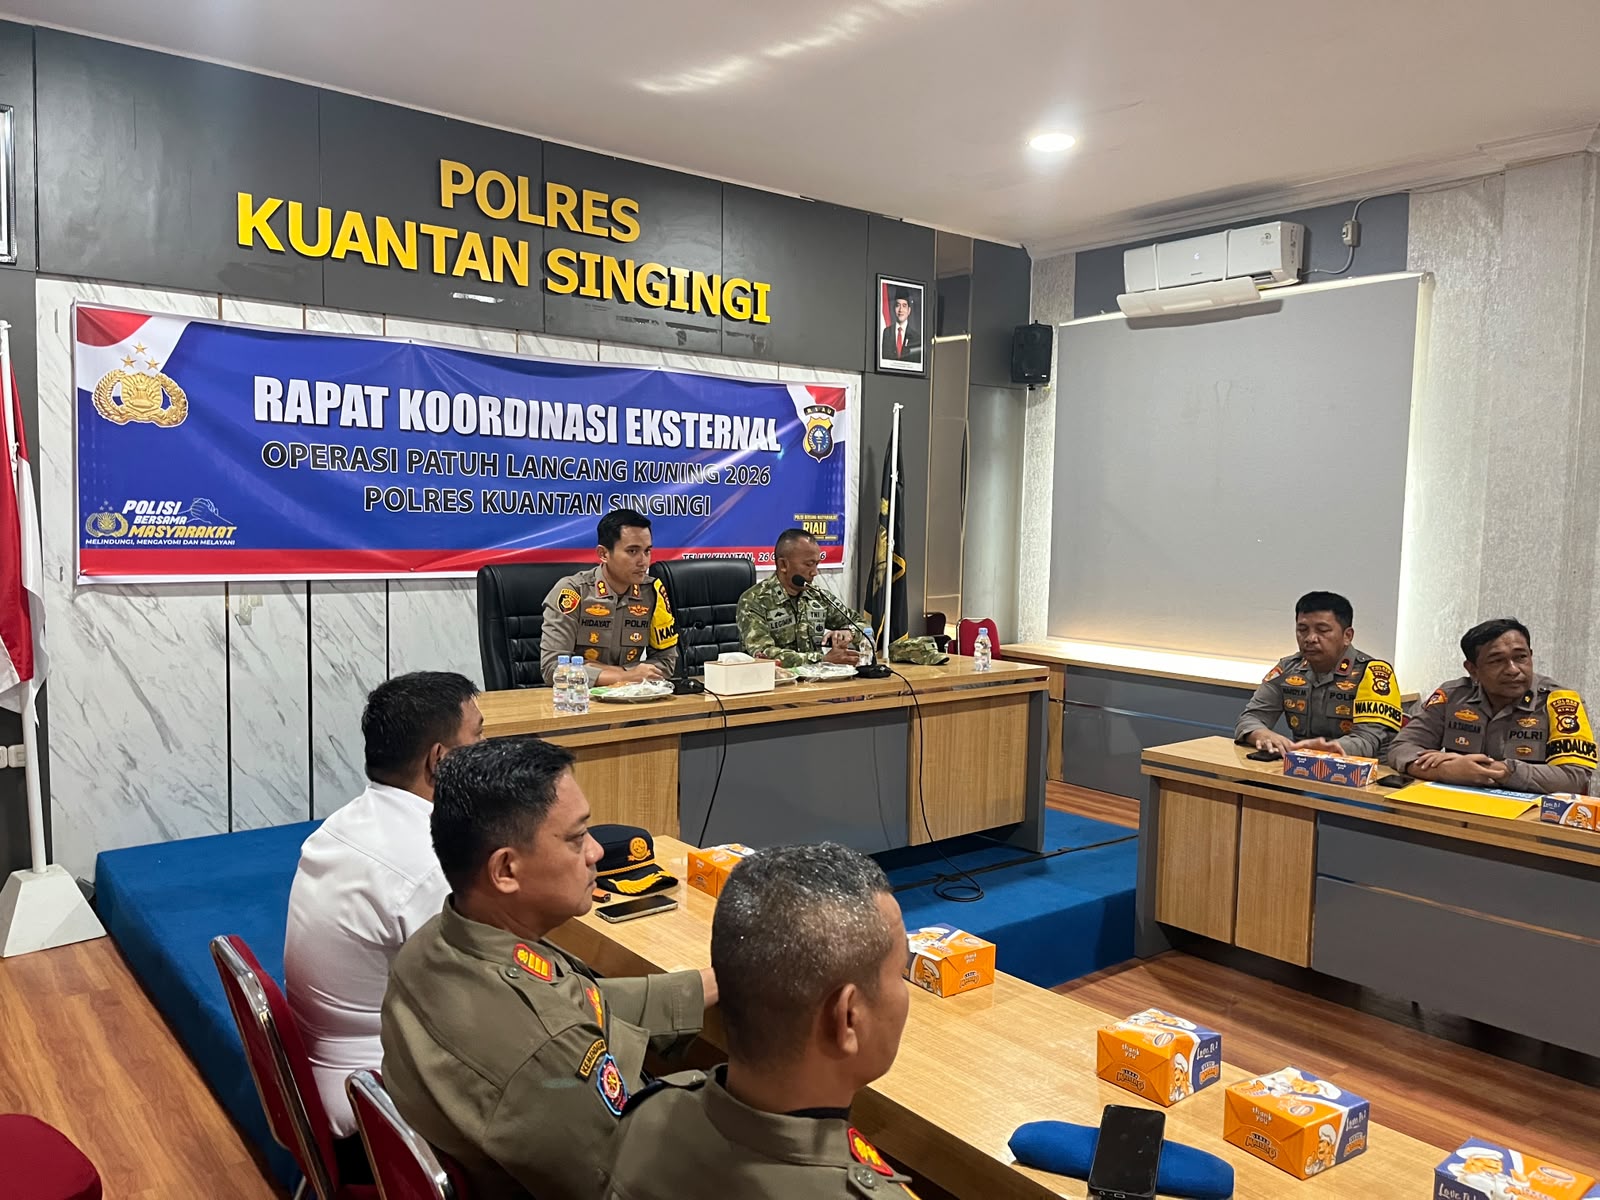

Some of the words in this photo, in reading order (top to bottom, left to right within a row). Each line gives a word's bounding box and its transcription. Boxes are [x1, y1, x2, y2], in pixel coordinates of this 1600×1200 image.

[440, 158, 641, 242] POLRES
[237, 192, 530, 287] KUANTAN
[546, 248, 772, 325] SINGINGI
[254, 375, 389, 429] RAPAT
[399, 388, 618, 445] KOORDINASI
[626, 407, 782, 452] EKSTERNAL
[806, 406, 832, 415] RIAU
[262, 440, 398, 473] OPERASI
[407, 449, 499, 477] PATUH
[507, 454, 627, 482] LANCANG
[633, 460, 720, 484] KUNING
[724, 464, 771, 485] 2026
[122, 500, 182, 515] POLISI
[364, 486, 473, 513] POLRES
[481, 489, 603, 516] KUANTAN
[609, 493, 711, 517] SINGINGI
[133, 515, 188, 525] BERSAMA
[127, 525, 238, 538] MASYARAKAT
[803, 521, 826, 535] RIAU
[759, 552, 769, 561] 26
[581, 619, 611, 629] HIDAYAT
[624, 619, 649, 628] POLRI
[1329, 692, 1355, 701] POLR
[1508, 729, 1543, 740] POLRI
[1121, 1043, 1140, 1056] thank
[1124, 1051, 1136, 1059] you
[1252, 1107, 1272, 1121] thank
[1255, 1115, 1268, 1125] you
